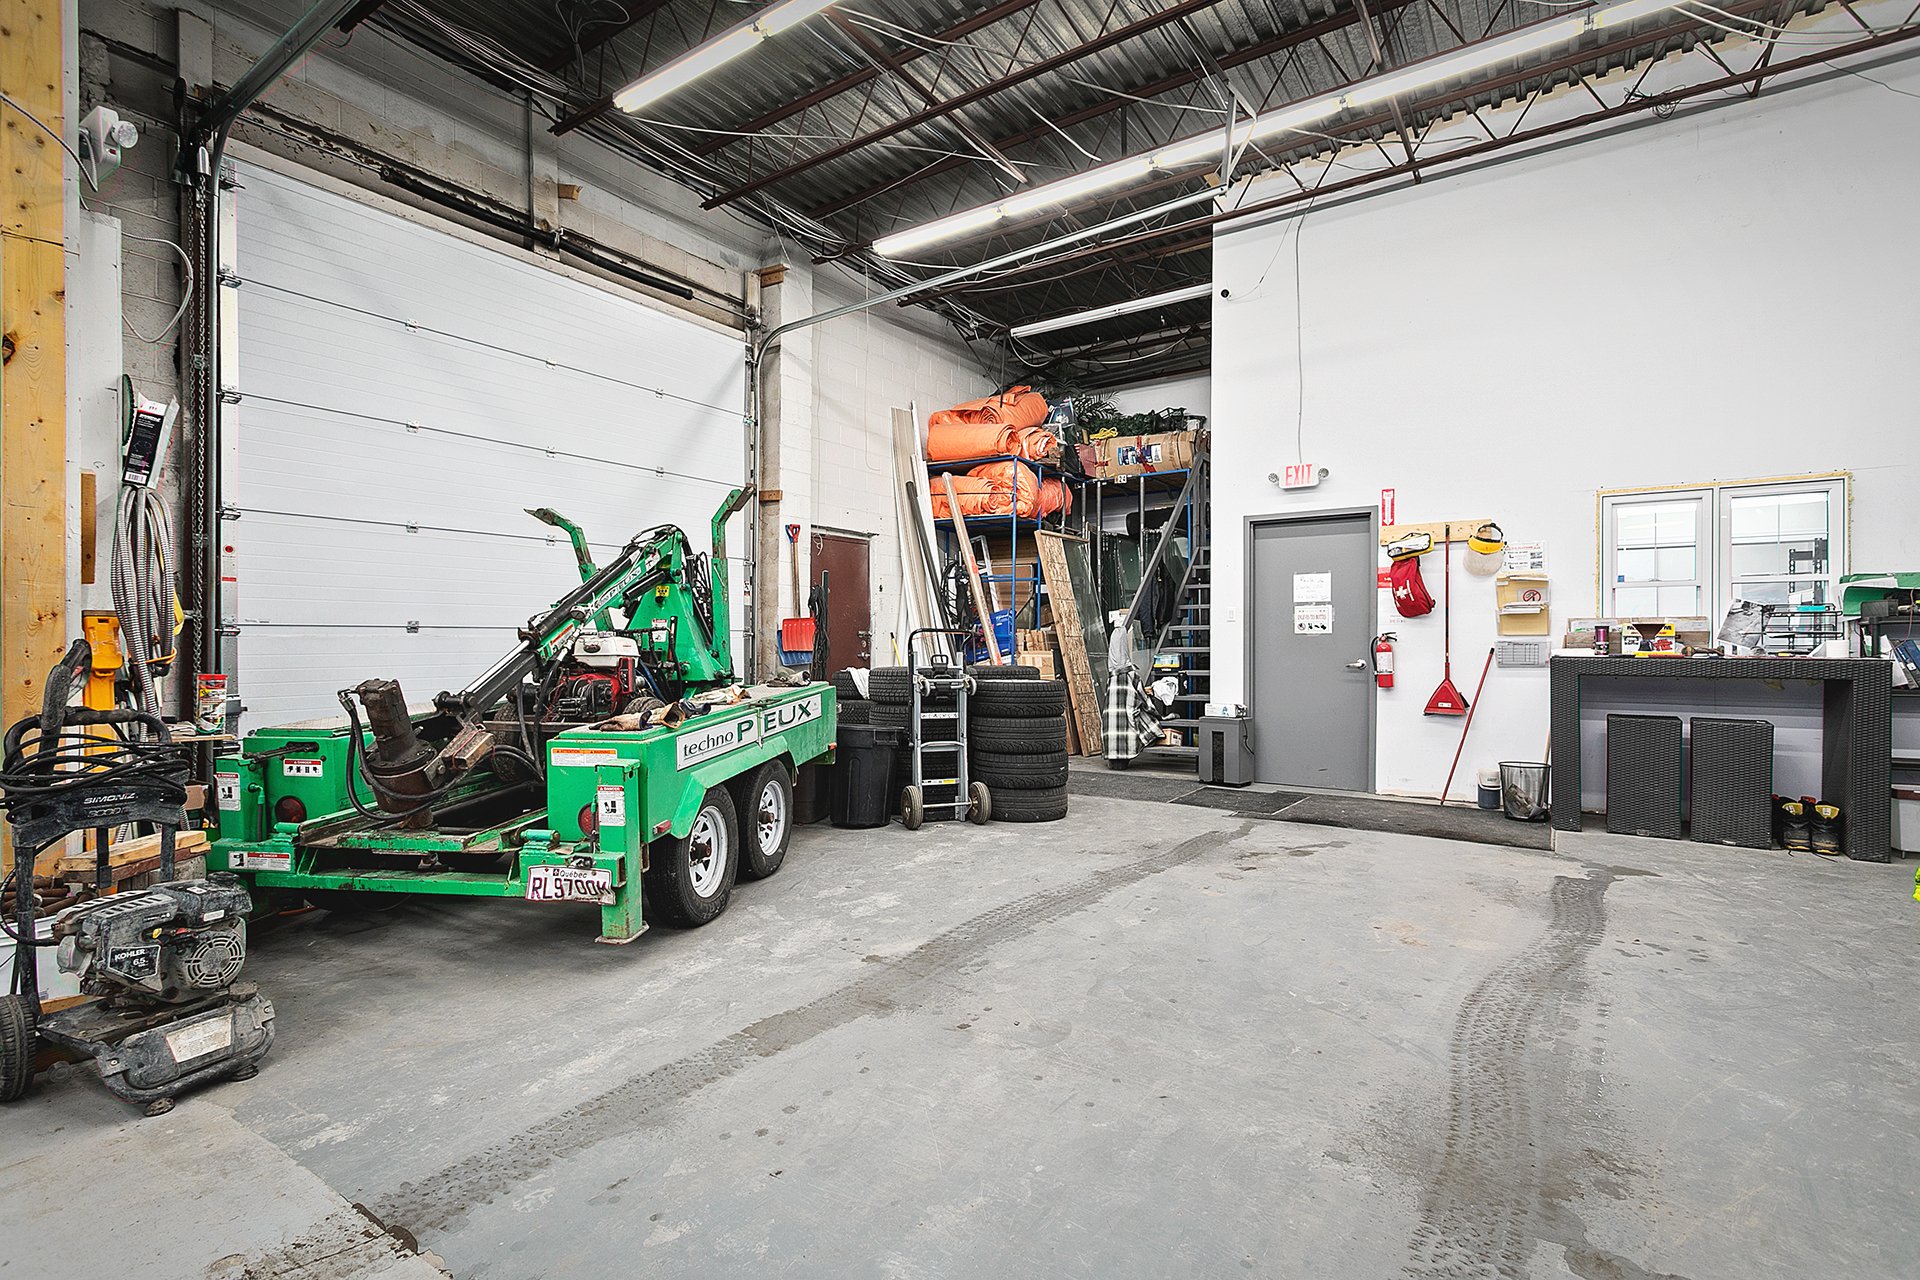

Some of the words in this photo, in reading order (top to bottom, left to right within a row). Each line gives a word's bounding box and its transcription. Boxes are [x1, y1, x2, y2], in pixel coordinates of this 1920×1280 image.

[1285, 464, 1312, 486] EXIT
[683, 731, 734, 757] techno
[737, 700, 812, 742] PEUX
[83, 792, 136, 804] SIMONIZ
[560, 870, 588, 879] Québec
[114, 948, 146, 961] KOHLER
